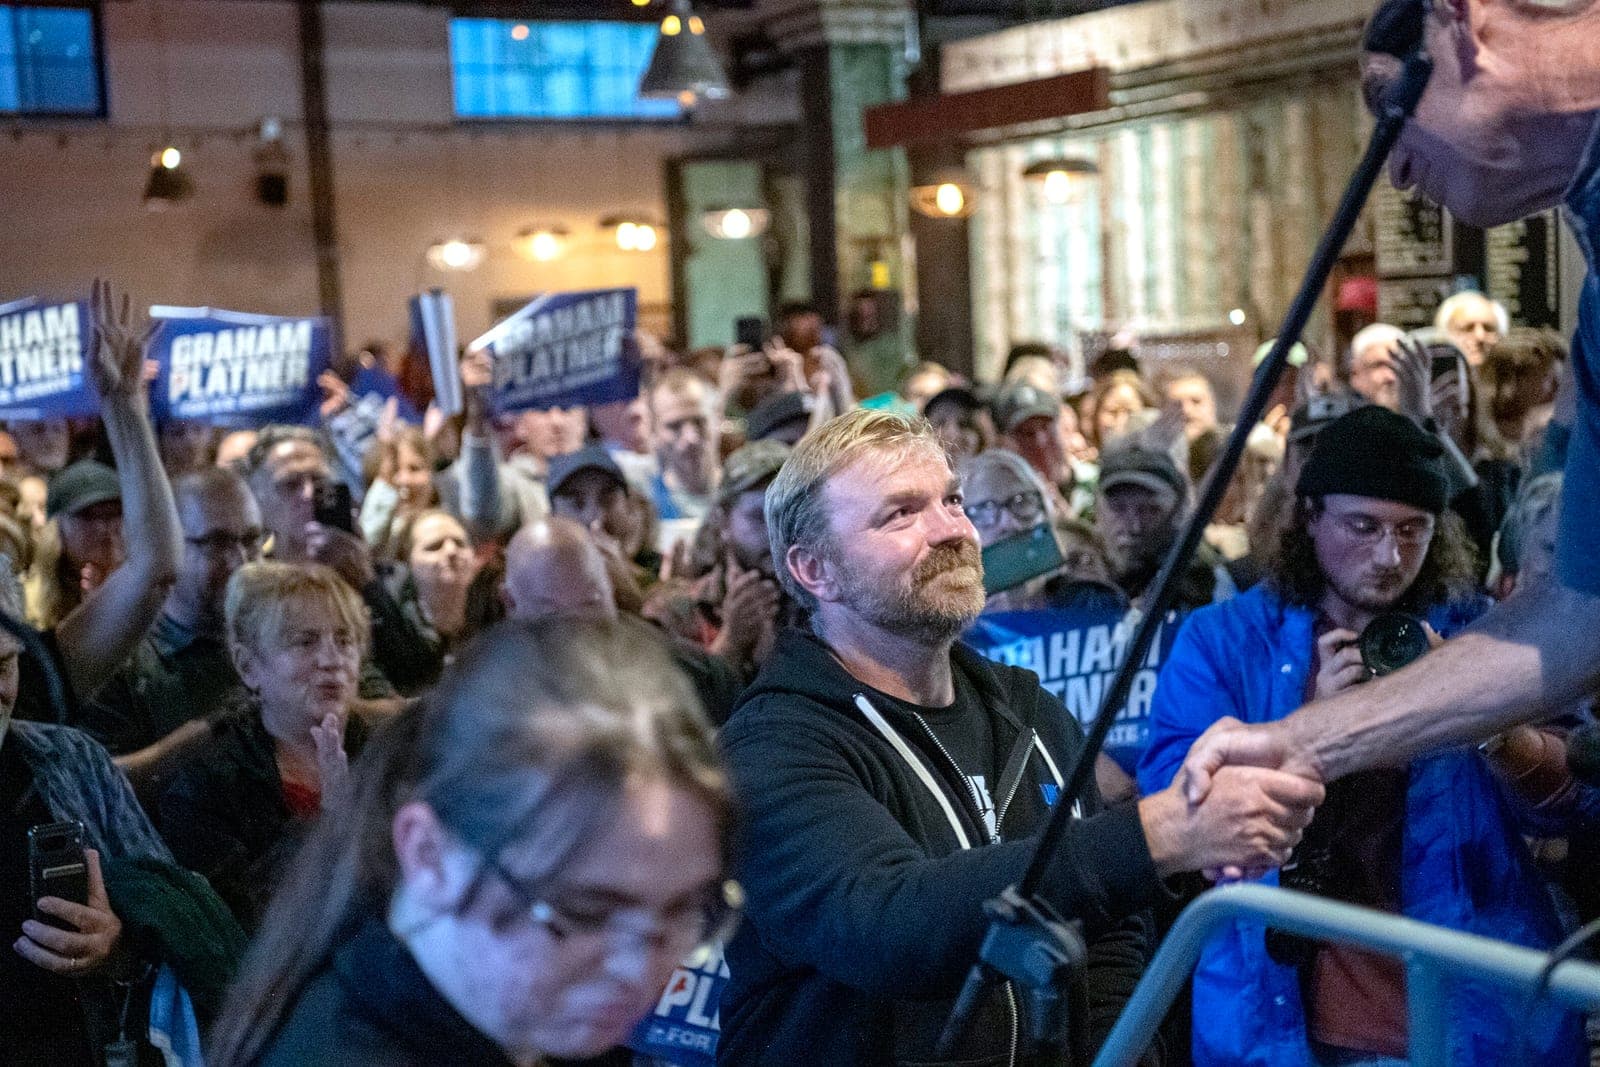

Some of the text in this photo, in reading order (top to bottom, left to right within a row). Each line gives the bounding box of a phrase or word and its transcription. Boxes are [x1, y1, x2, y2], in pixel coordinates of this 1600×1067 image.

[171, 320, 311, 367] GRAHAM
[169, 353, 311, 404] PLATNER
[655, 968, 720, 1031] PL
